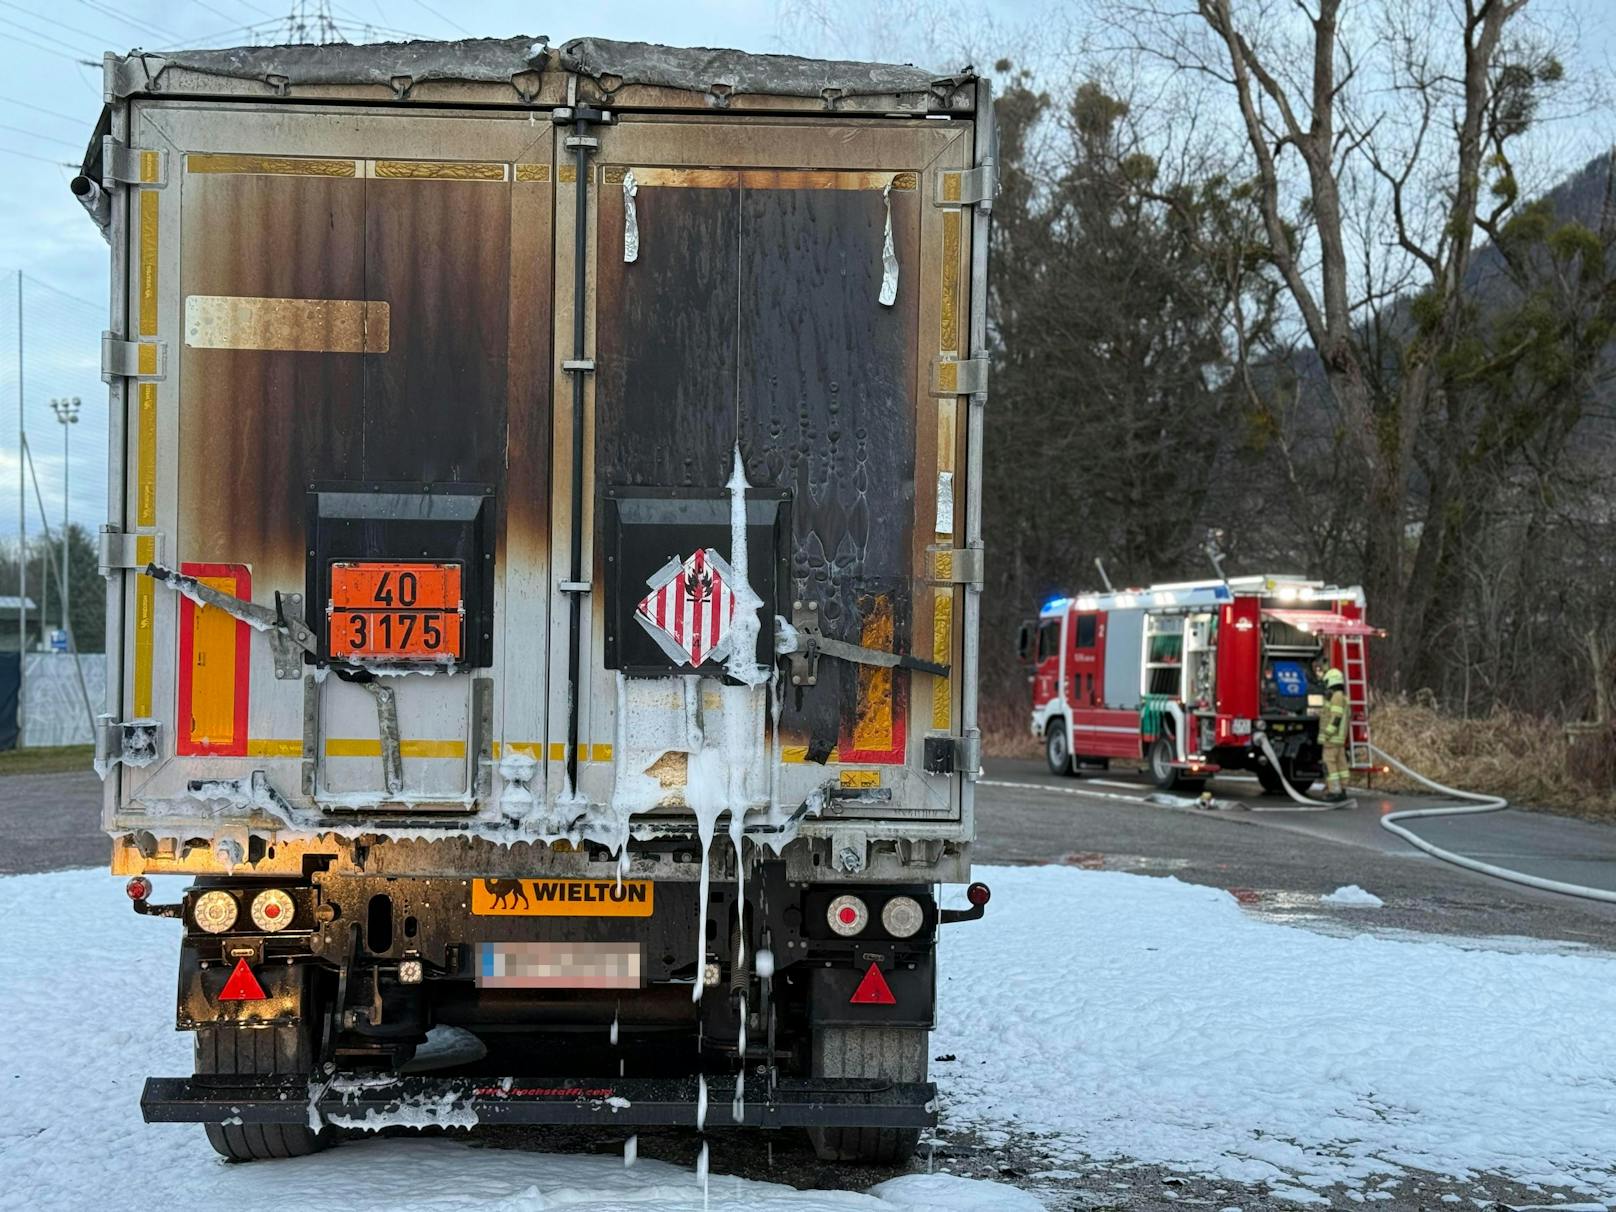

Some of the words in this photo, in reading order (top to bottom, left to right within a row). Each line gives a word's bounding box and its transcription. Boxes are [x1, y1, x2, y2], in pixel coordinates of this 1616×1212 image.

[374, 572, 417, 607] 40
[350, 614, 440, 650] 3175
[533, 883, 646, 902] WIELTON
